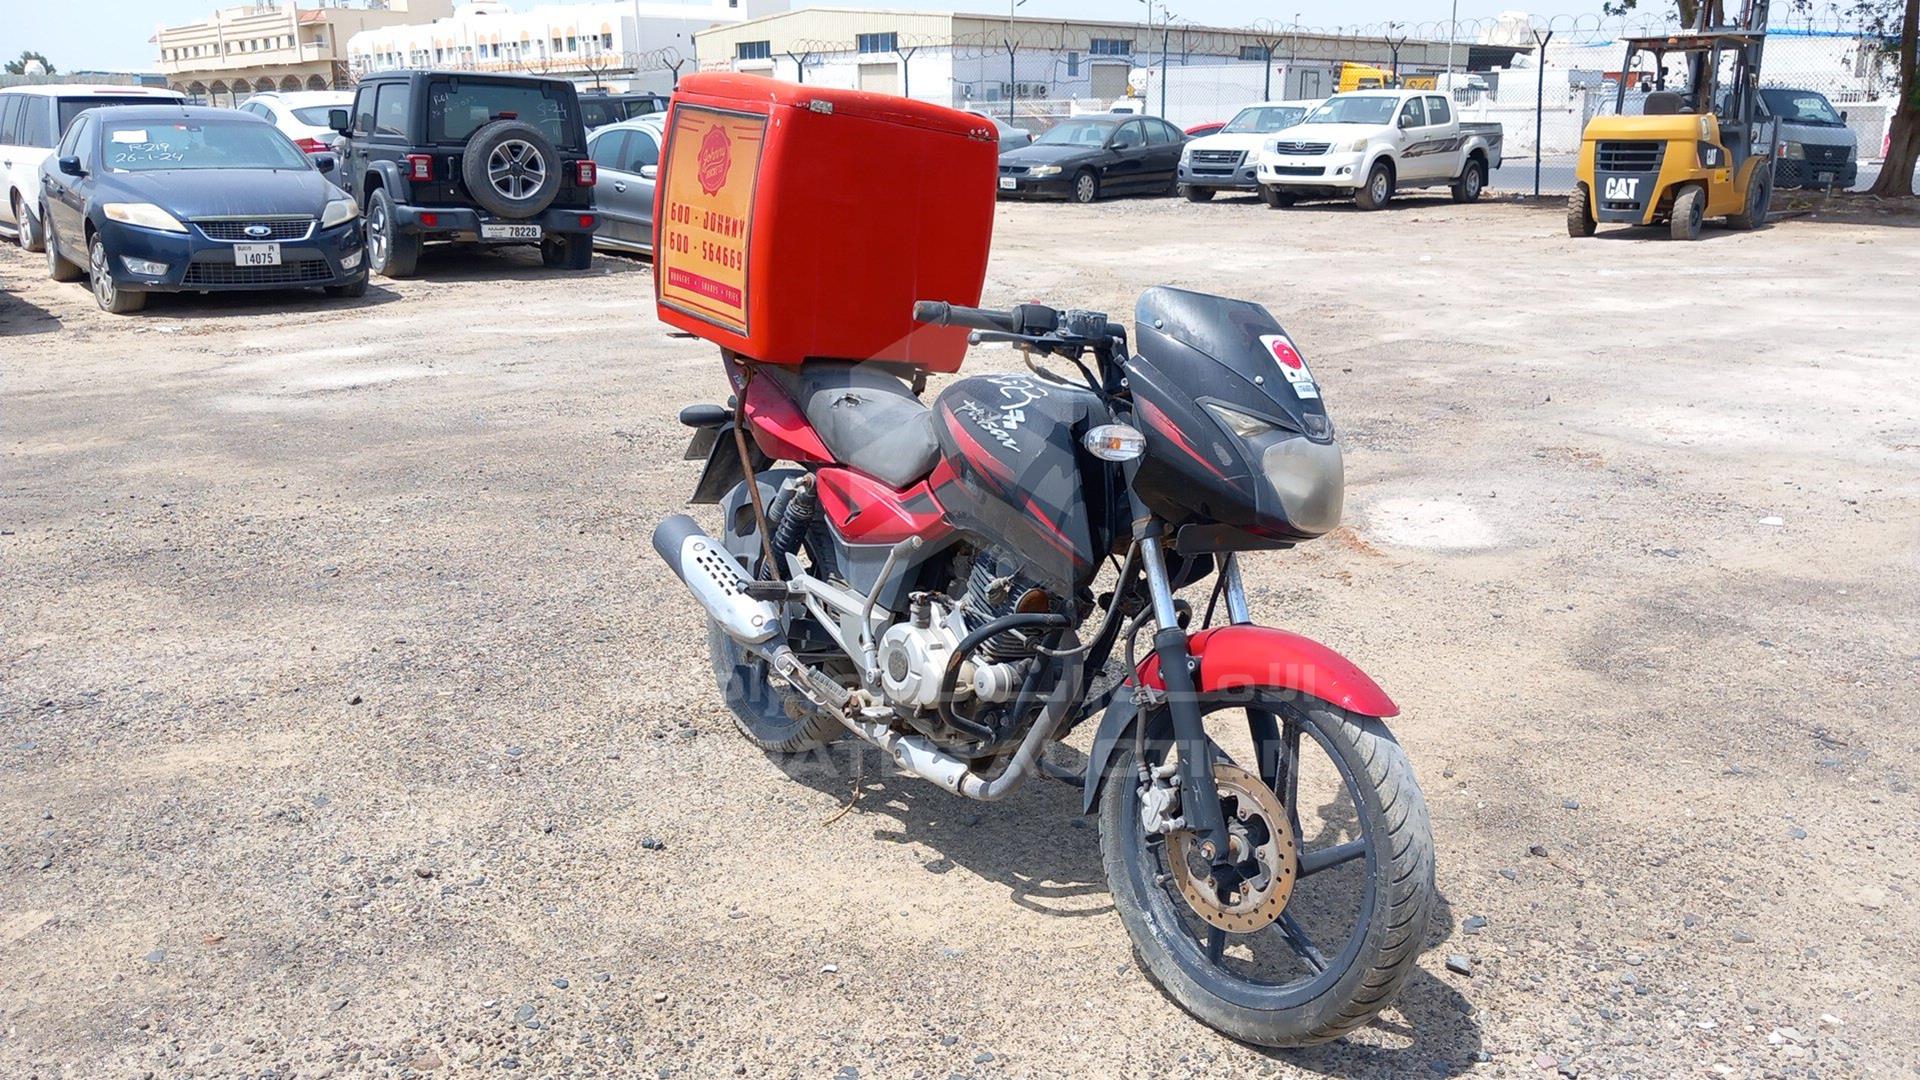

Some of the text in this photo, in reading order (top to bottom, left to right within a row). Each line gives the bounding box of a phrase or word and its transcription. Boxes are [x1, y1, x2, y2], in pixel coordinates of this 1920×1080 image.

[1605, 177, 1639, 199] CAT
[509, 226, 537, 237] 78228
[671, 202, 690, 225] 600
[703, 211, 745, 239] JOHNNY
[245, 252, 274, 264] 14075
[670, 231, 689, 254] 600
[702, 240, 742, 271] 564669
